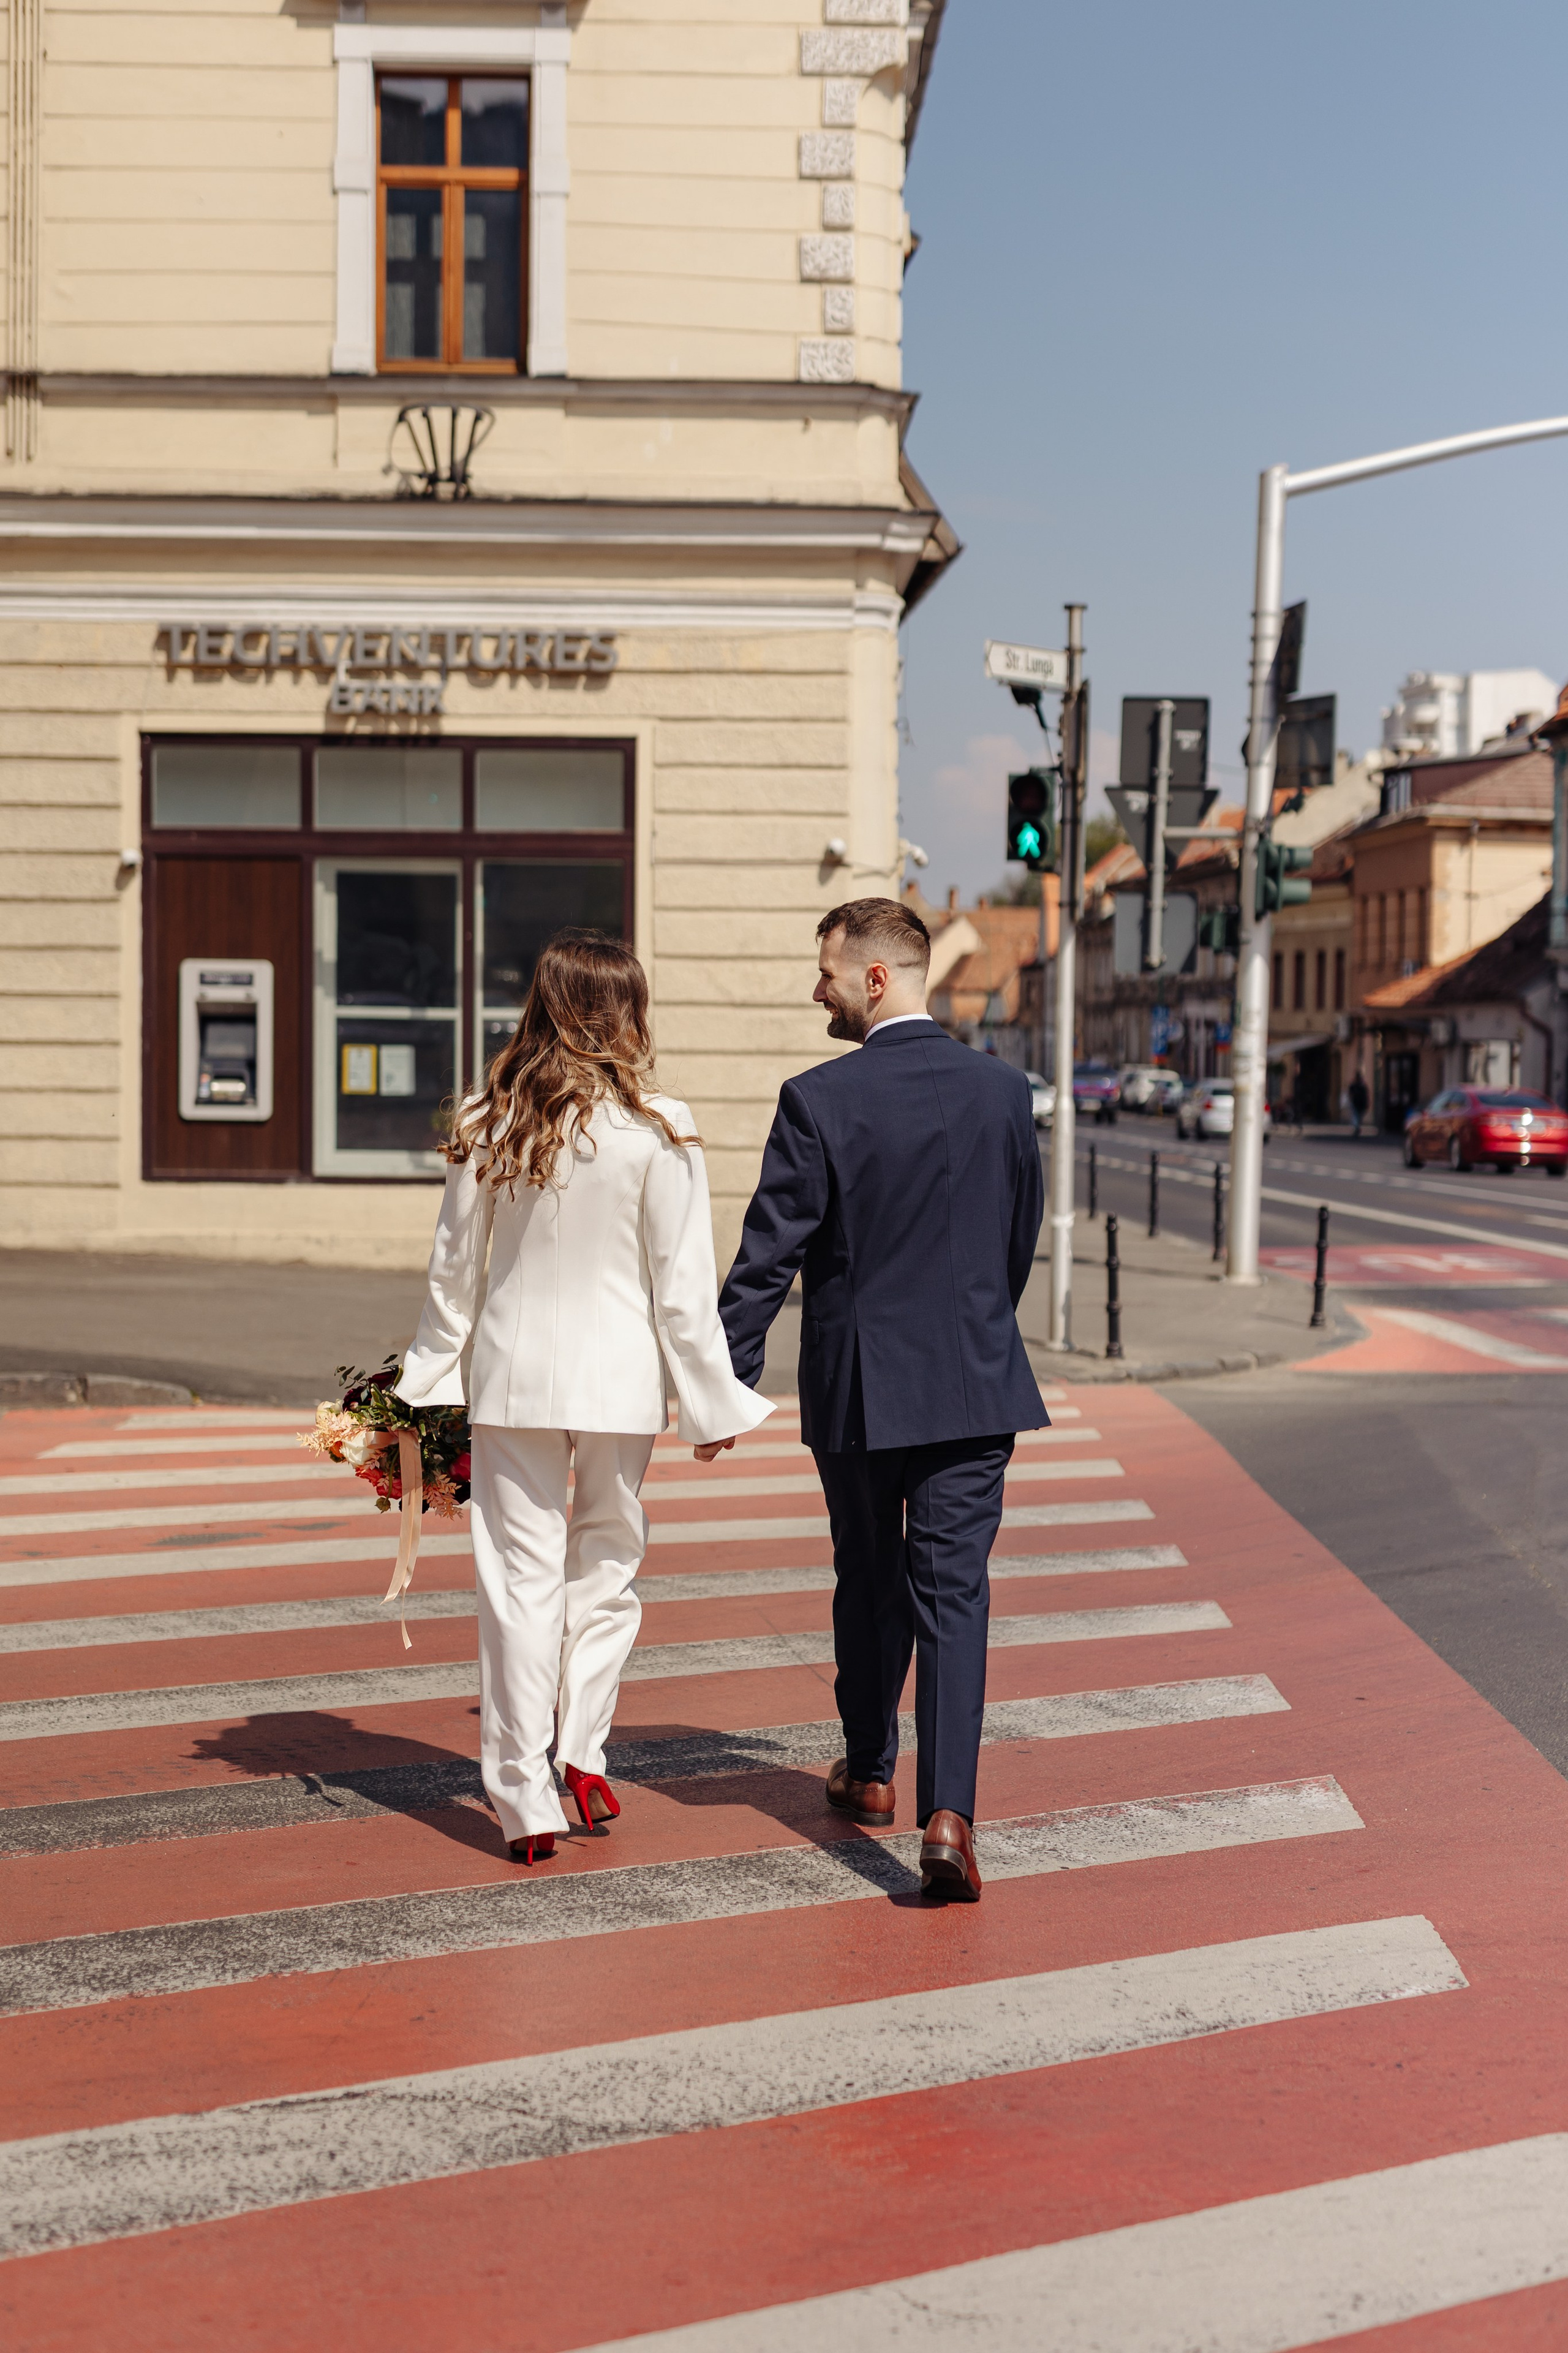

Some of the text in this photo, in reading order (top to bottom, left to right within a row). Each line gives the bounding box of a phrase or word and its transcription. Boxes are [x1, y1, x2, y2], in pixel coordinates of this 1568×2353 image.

[162, 624, 619, 671] TECHVENTURES
[1006, 648, 1023, 670] Str.
[331, 679, 445, 714] BANK
